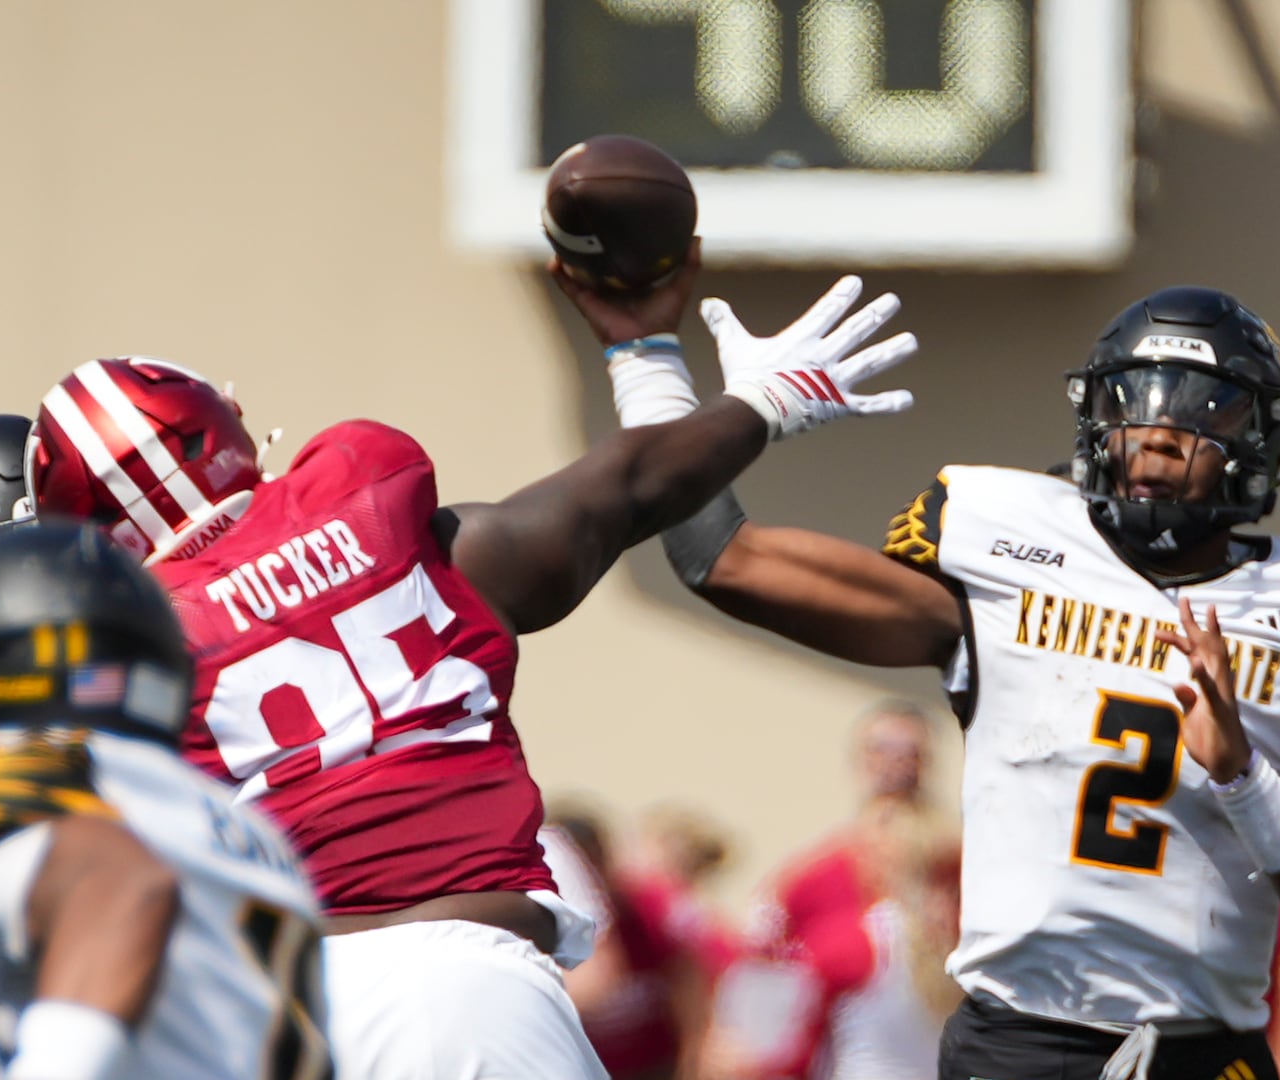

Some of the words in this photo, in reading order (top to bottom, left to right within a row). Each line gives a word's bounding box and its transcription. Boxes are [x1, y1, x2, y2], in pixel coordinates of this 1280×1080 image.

[205, 519, 376, 633] TUCKER
[1015, 587, 1178, 673] KENNESAW
[204, 562, 499, 806] 95
[1069, 687, 1185, 877] 2
